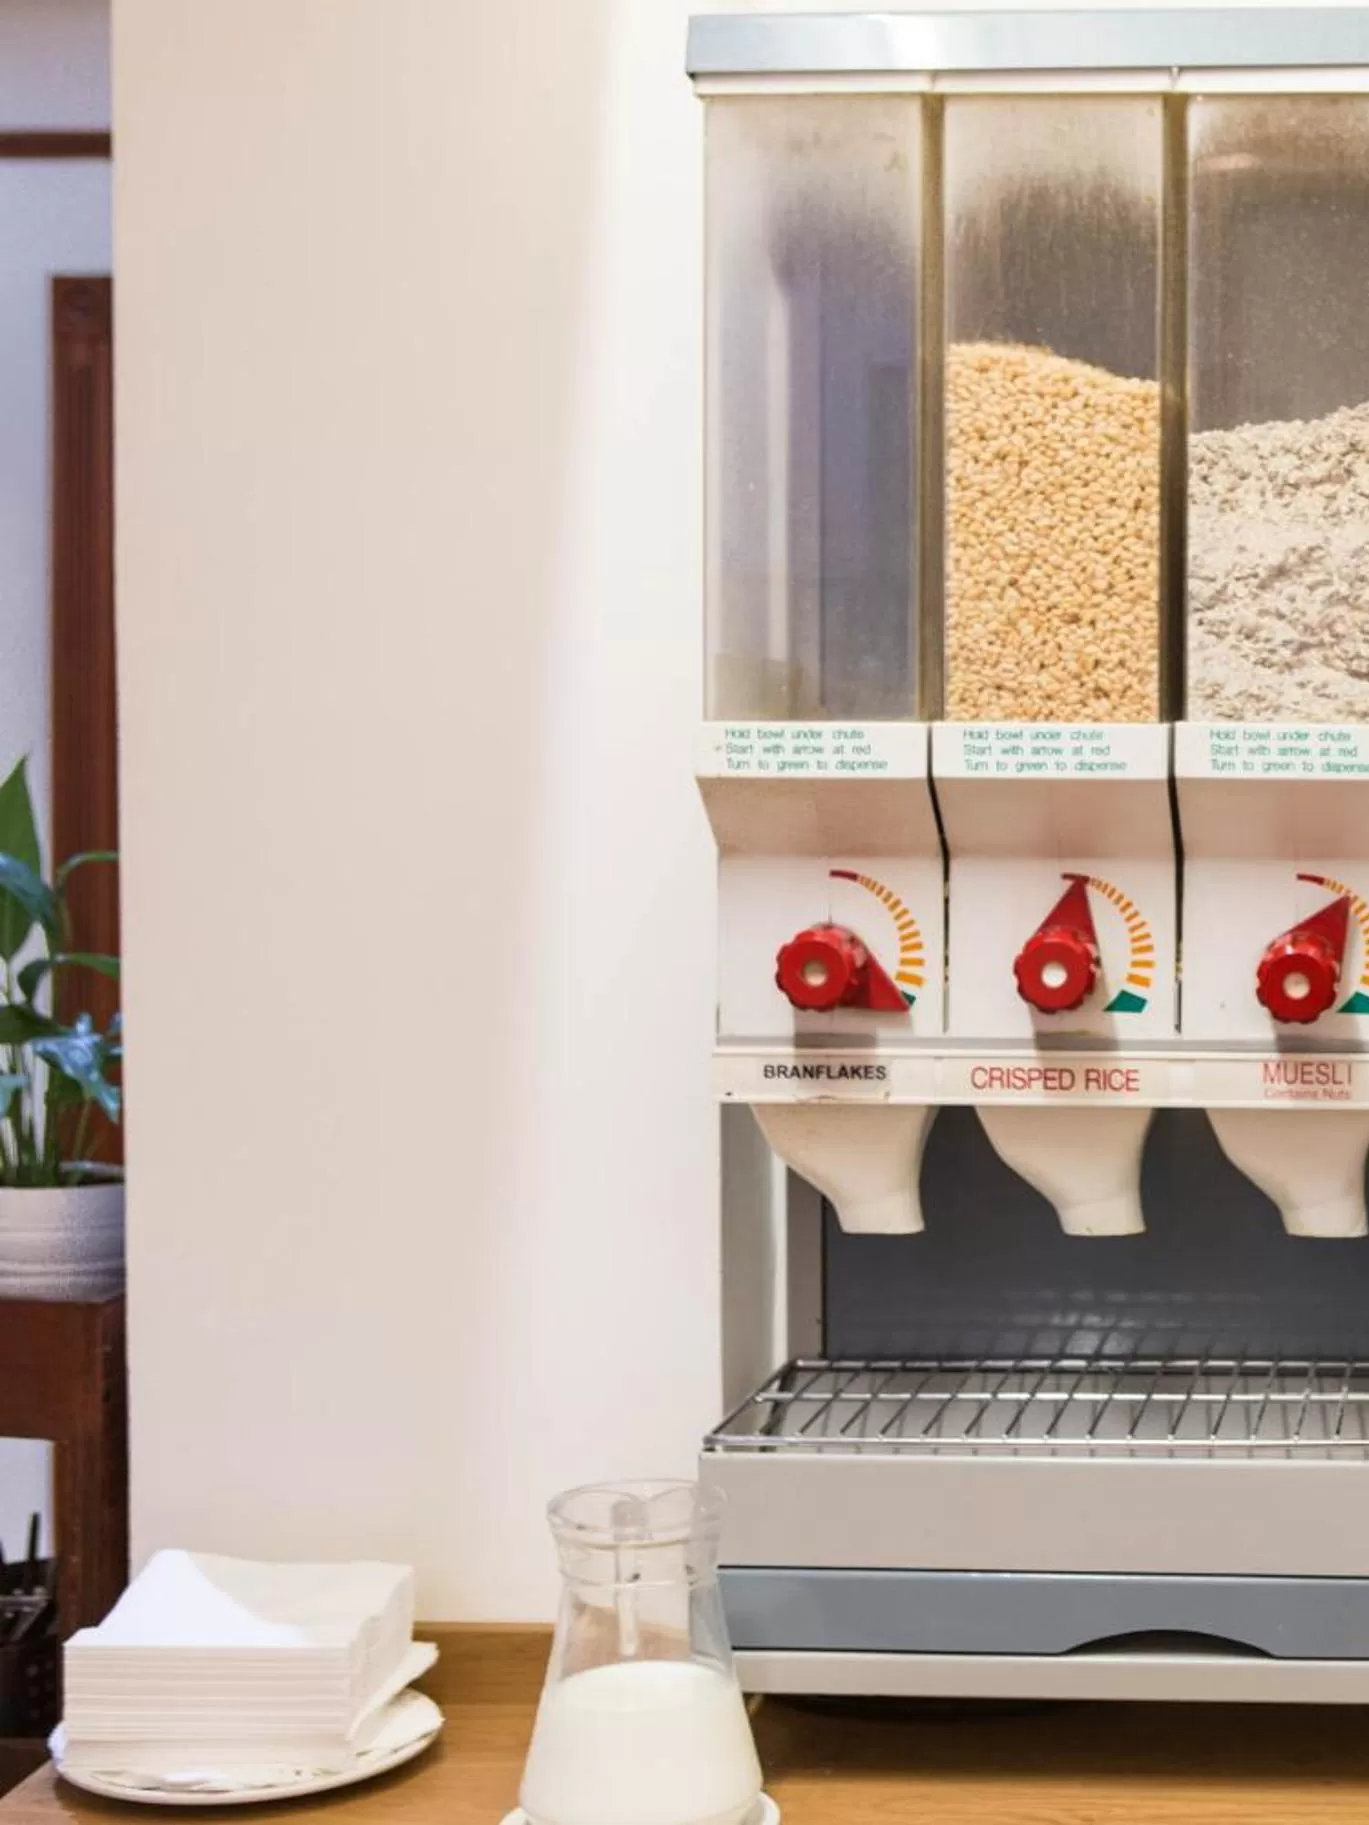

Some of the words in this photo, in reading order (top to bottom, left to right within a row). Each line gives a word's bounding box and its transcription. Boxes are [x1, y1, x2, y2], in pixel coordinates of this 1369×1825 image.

[757, 729, 784, 739] bowl
[791, 729, 823, 739] under
[996, 730, 1023, 741] bowl
[1030, 730, 1061, 741] under
[1242, 730, 1270, 741] bowl
[1277, 730, 1309, 741] under
[726, 744, 753, 755] Start
[763, 744, 785, 755] with
[792, 746, 824, 755] arrow
[832, 744, 845, 755] at
[852, 744, 871, 755] red
[964, 745, 992, 756] Start
[1001, 745, 1023, 756] with
[1031, 746, 1063, 756] arrow
[1072, 745, 1083, 756] at
[1091, 745, 1110, 756] red
[1211, 745, 1239, 756] Start
[1248, 745, 1271, 756] with
[1278, 747, 1311, 756] arrow
[1320, 745, 1330, 756] at
[1338, 746, 1357, 757] red
[727, 759, 749, 770] Turn
[759, 759, 769, 770] to
[777, 761, 809, 772] green
[817, 759, 828, 770] to
[835, 759, 888, 771] dispense
[965, 760, 988, 771] Turn
[996, 760, 1007, 771] to
[1015, 762, 1048, 773] green
[1055, 760, 1066, 771] to
[1074, 760, 1127, 772] dispense
[1212, 759, 1235, 771] Turn
[1243, 760, 1254, 771] to
[1263, 761, 1295, 772] green
[1302, 760, 1313, 772] to
[763, 1065, 886, 1080] BRANFLAKES
[1263, 1061, 1352, 1084] MUESLI
[970, 1067, 1075, 1091] CRISPED
[1085, 1068, 1139, 1092] RICE
